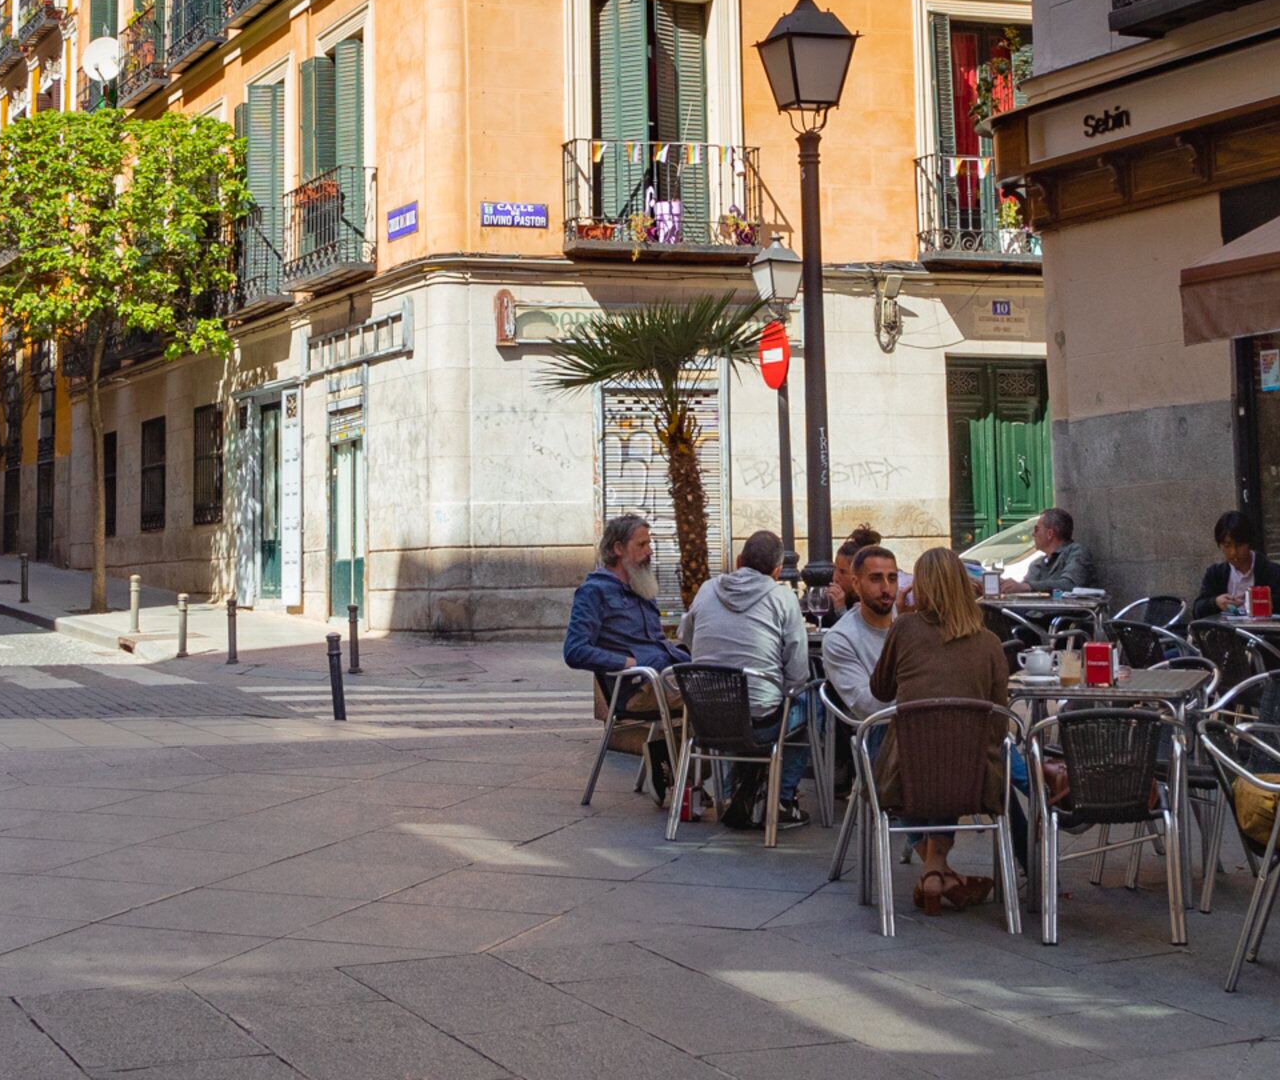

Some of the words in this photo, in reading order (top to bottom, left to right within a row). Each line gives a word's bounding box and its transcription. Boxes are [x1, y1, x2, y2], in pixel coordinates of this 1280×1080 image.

[497, 202, 534, 212] CALLE
[483, 214, 512, 226] DIVINO
[514, 216, 547, 227] PASTOR
[996, 302, 1009, 314] 10
